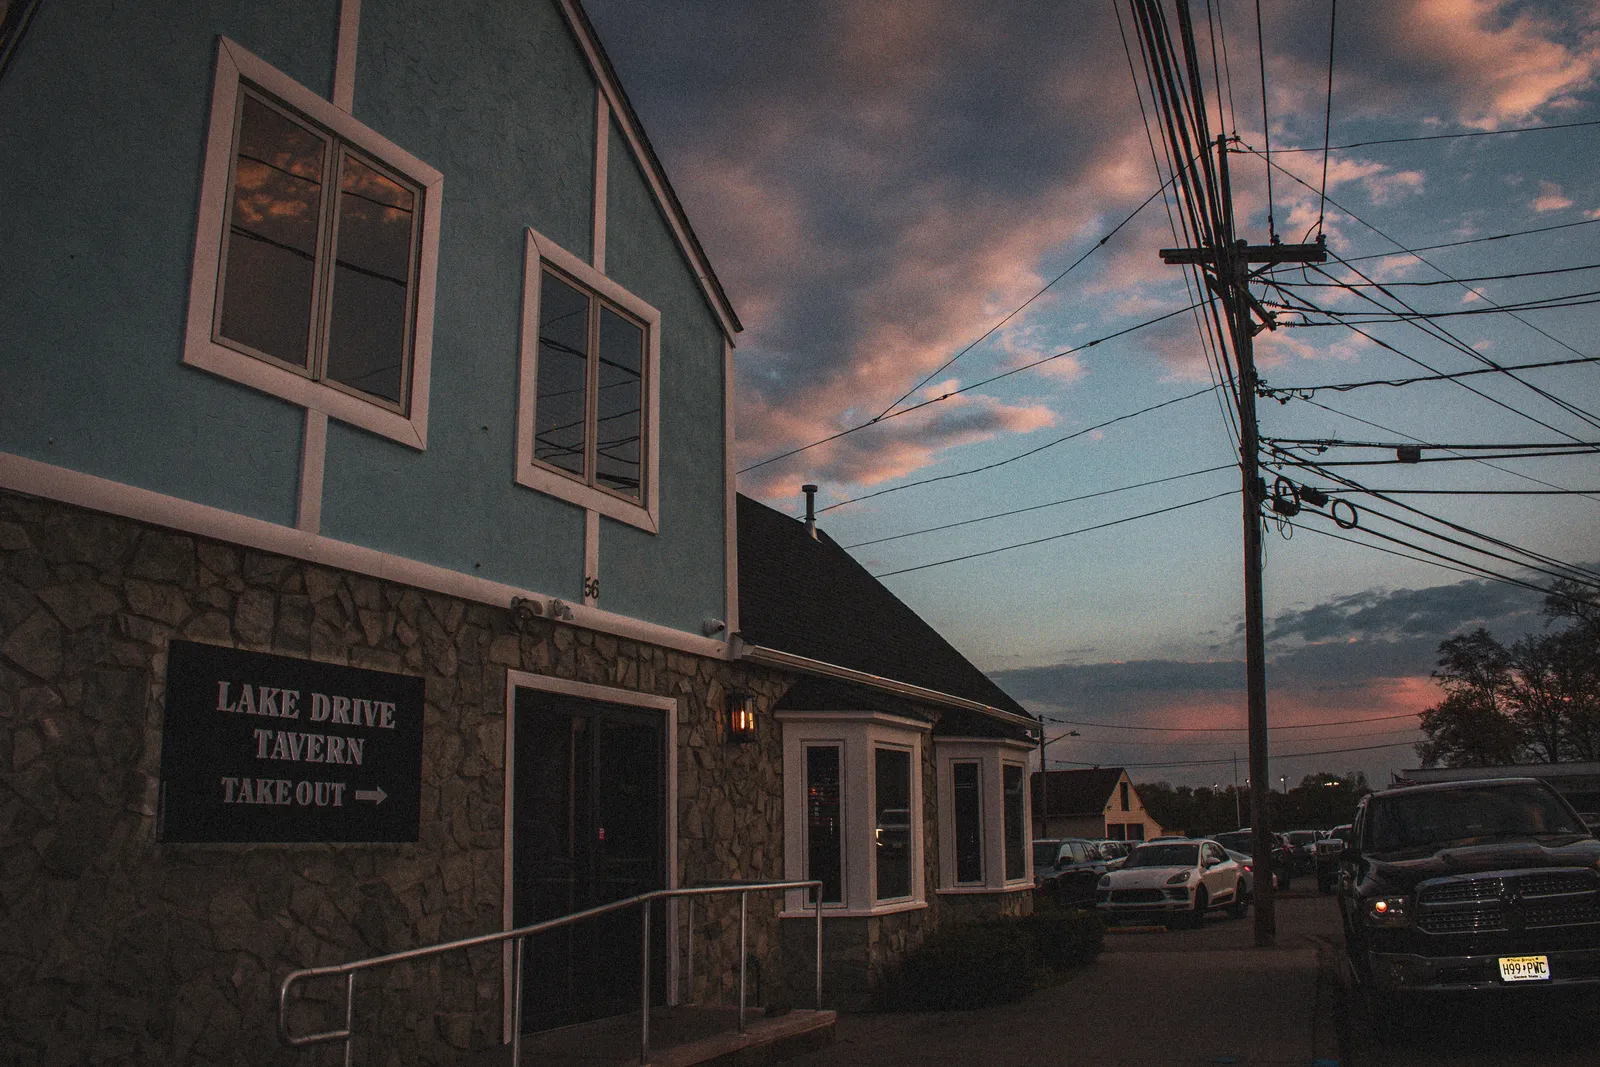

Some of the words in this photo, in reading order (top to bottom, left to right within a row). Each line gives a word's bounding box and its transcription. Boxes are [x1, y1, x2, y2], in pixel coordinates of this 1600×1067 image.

[585, 577, 600, 599] 56
[216, 681, 300, 719] LAKE
[310, 693, 396, 729] DRIVE
[254, 729, 364, 765] TAVERN
[221, 777, 292, 805] TAKE
[296, 781, 346, 807] OUT
